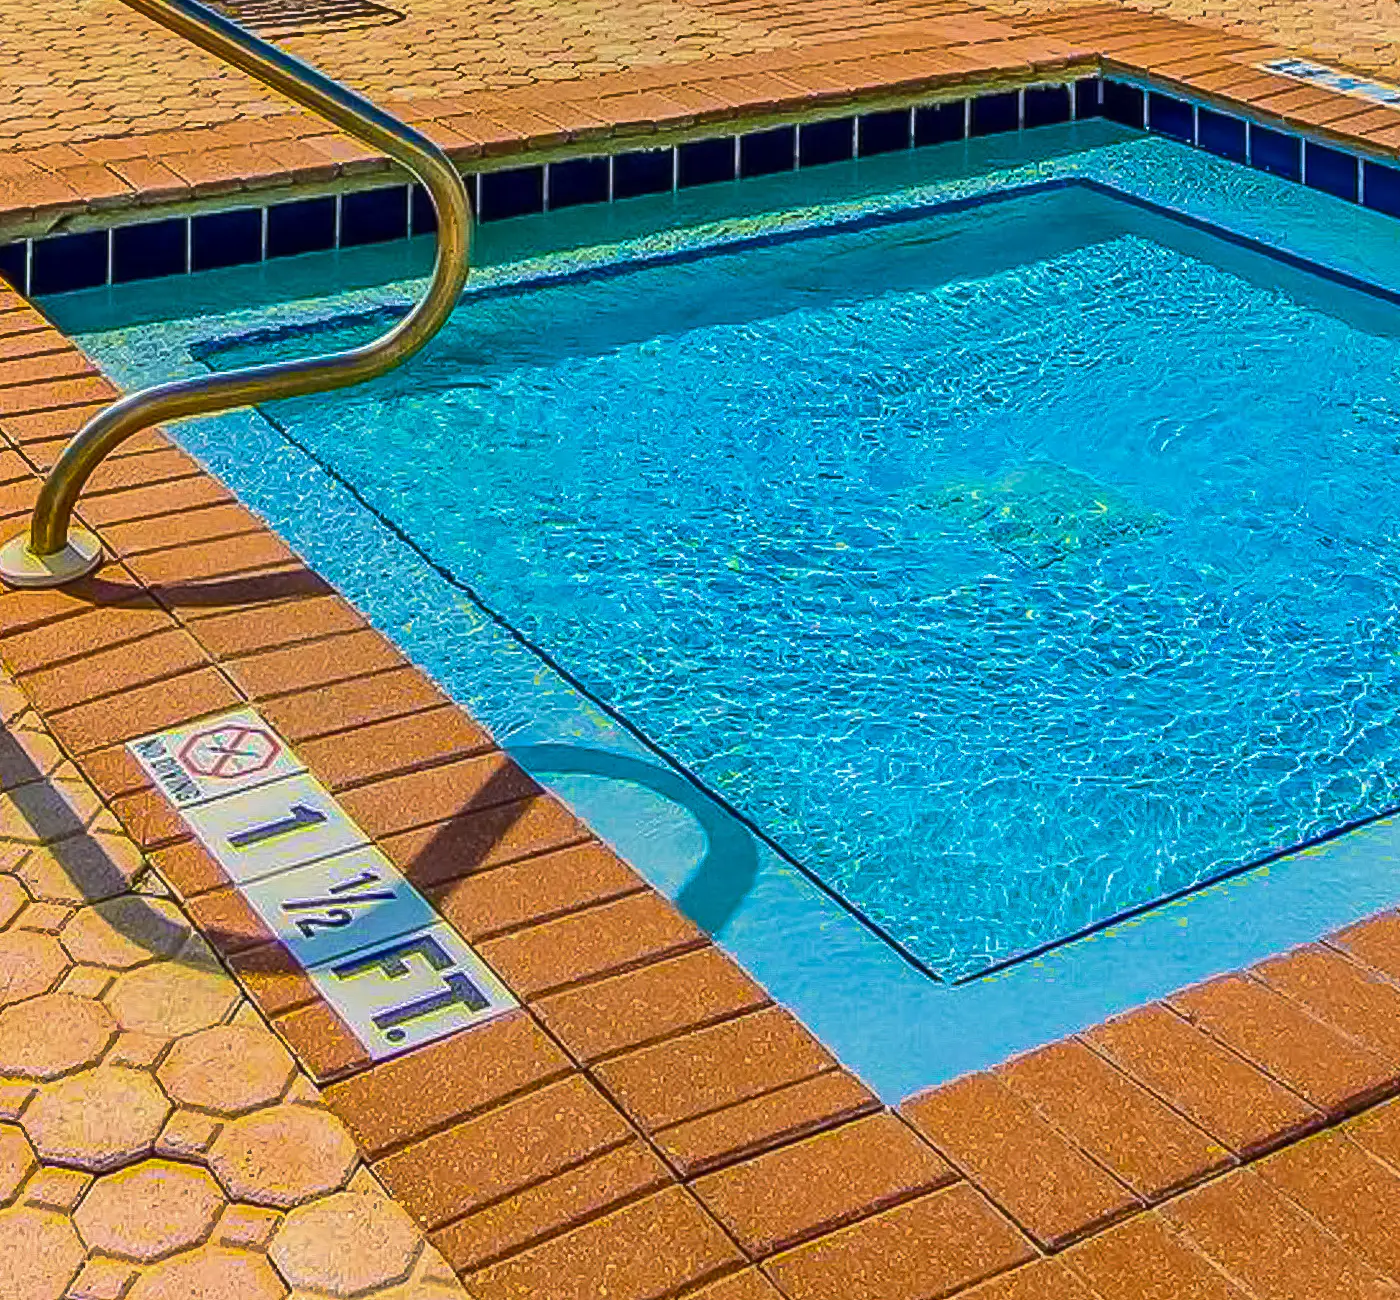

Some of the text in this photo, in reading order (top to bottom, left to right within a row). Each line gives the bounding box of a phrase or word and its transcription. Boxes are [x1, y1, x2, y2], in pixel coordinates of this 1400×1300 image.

[133, 736, 167, 759] NO
[226, 801, 328, 849] 1
[330, 933, 492, 1043] FT.
